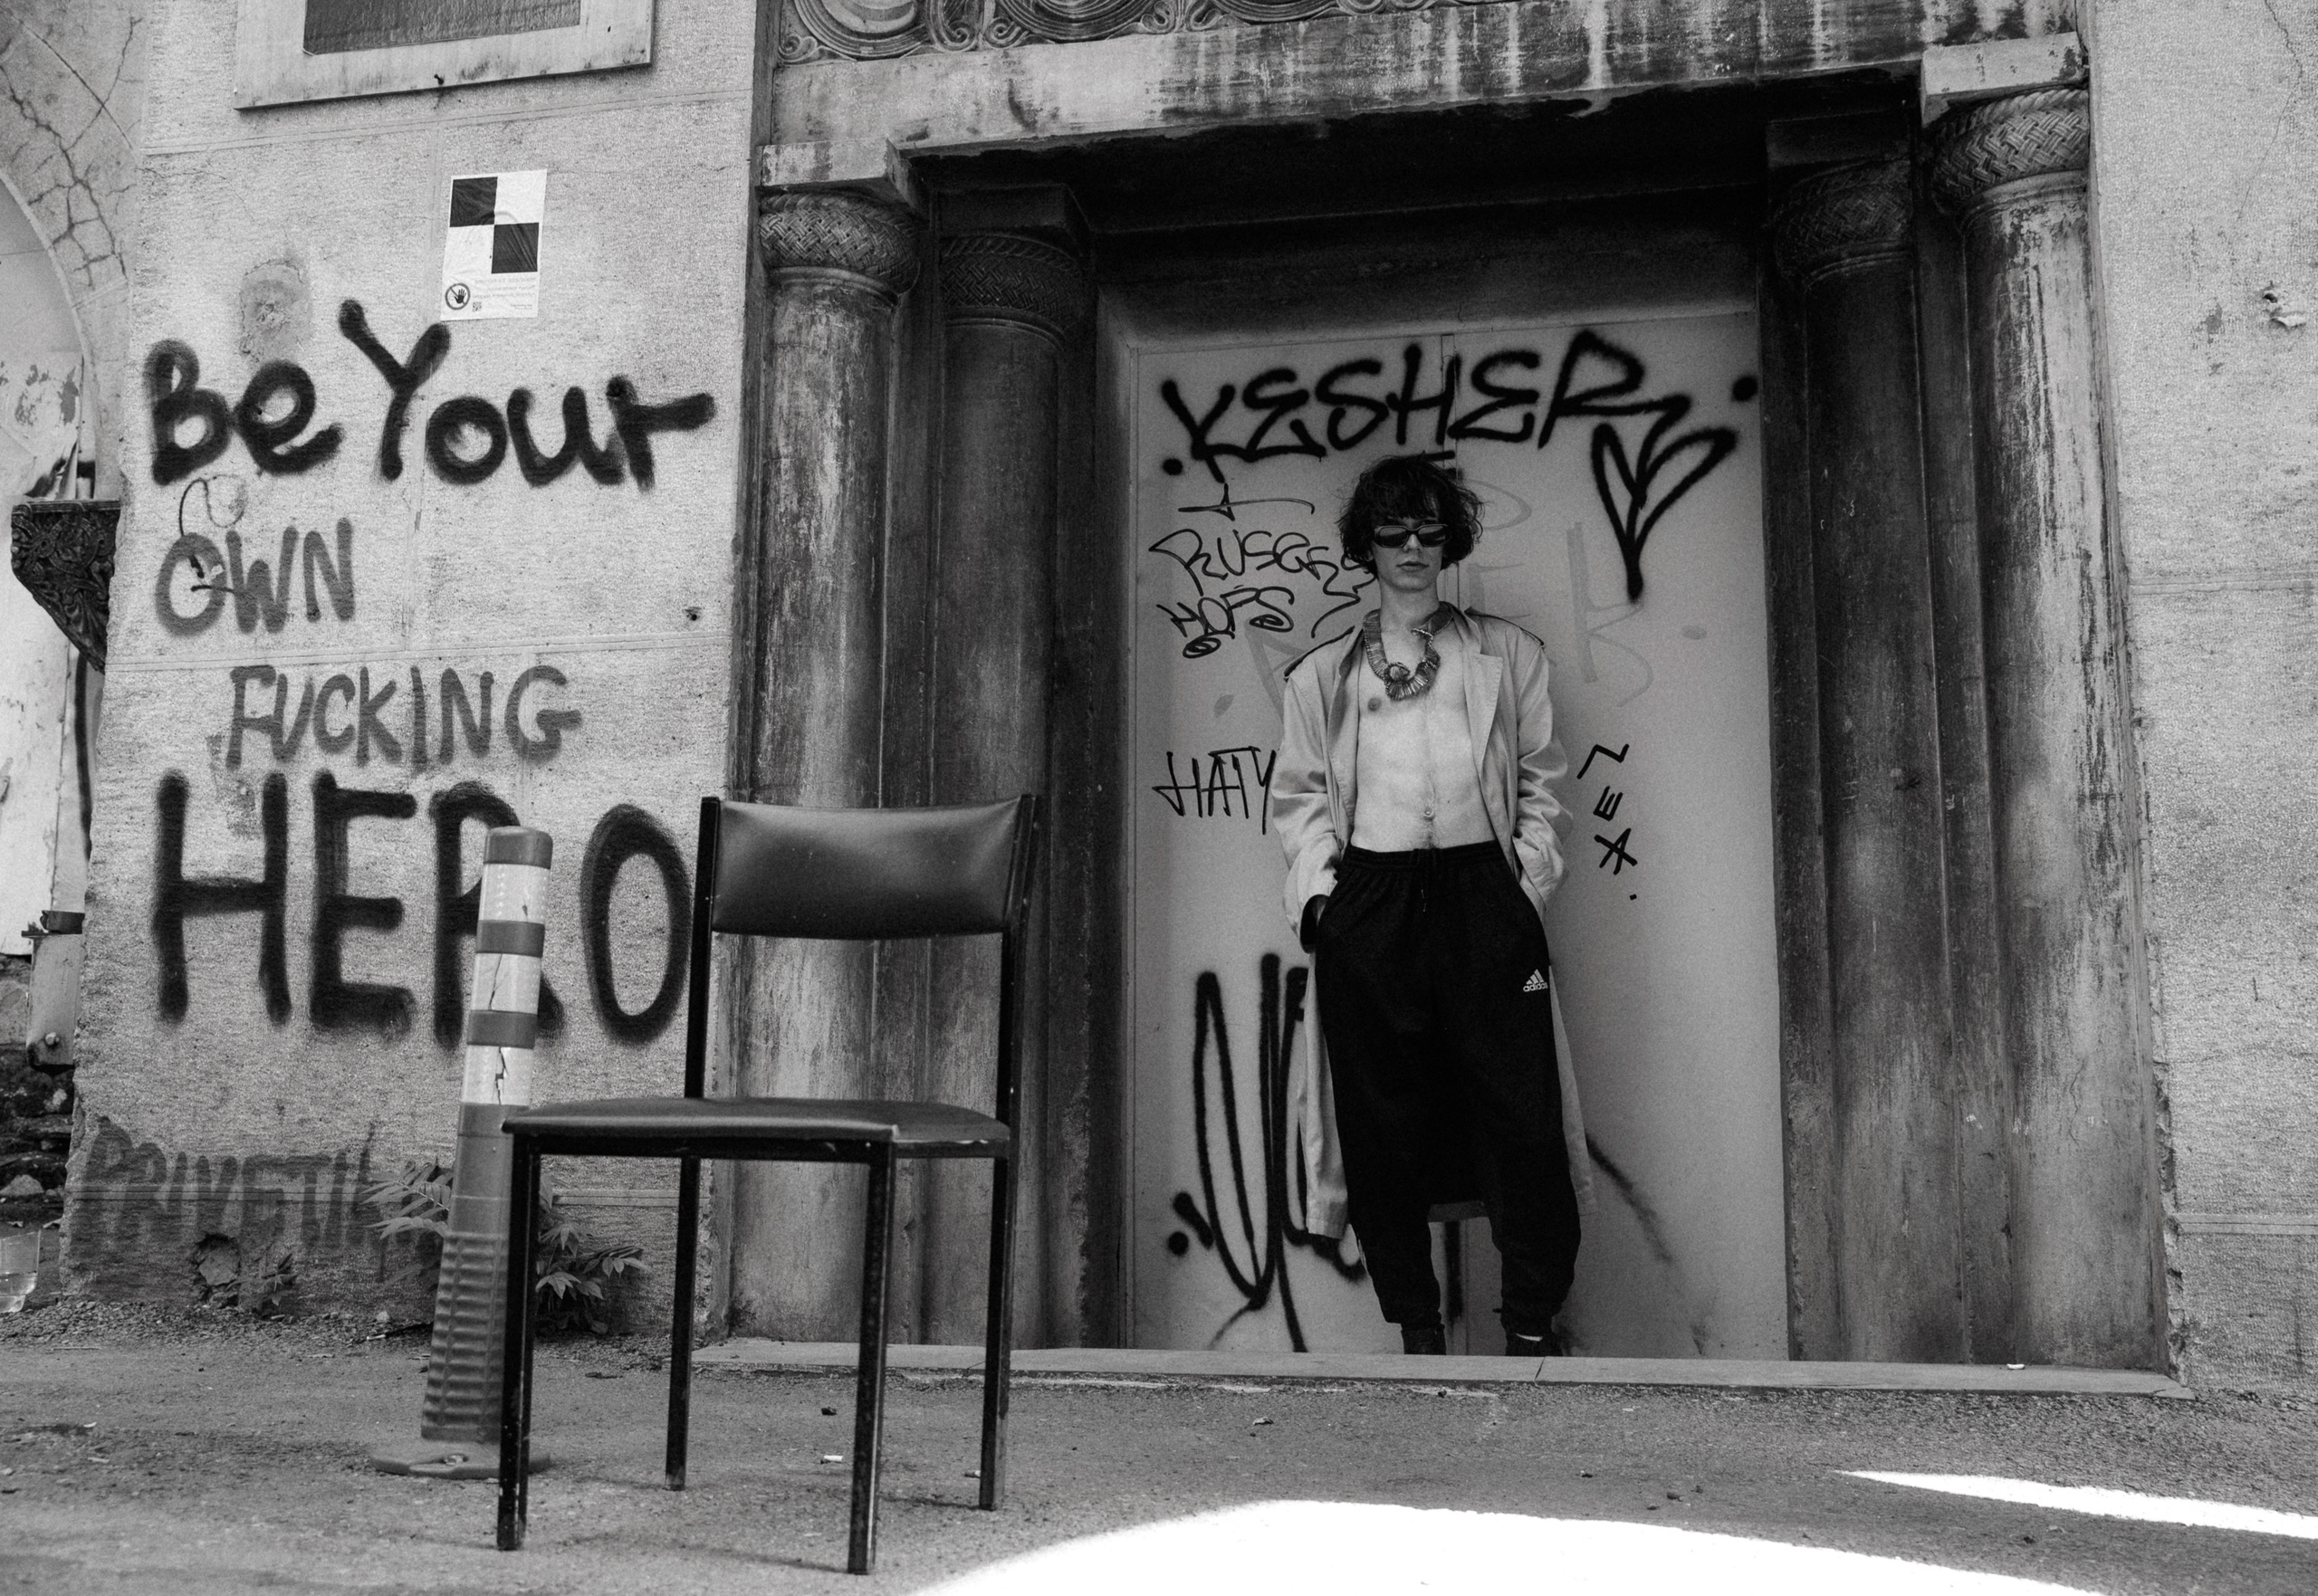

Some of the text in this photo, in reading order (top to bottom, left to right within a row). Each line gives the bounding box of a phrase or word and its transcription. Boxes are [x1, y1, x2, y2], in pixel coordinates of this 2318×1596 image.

[143, 299, 716, 493] Be Your
[155, 517, 356, 636] OWN
[224, 664, 582, 772] FUCKING
[1523, 982, 1548, 992] adidas
